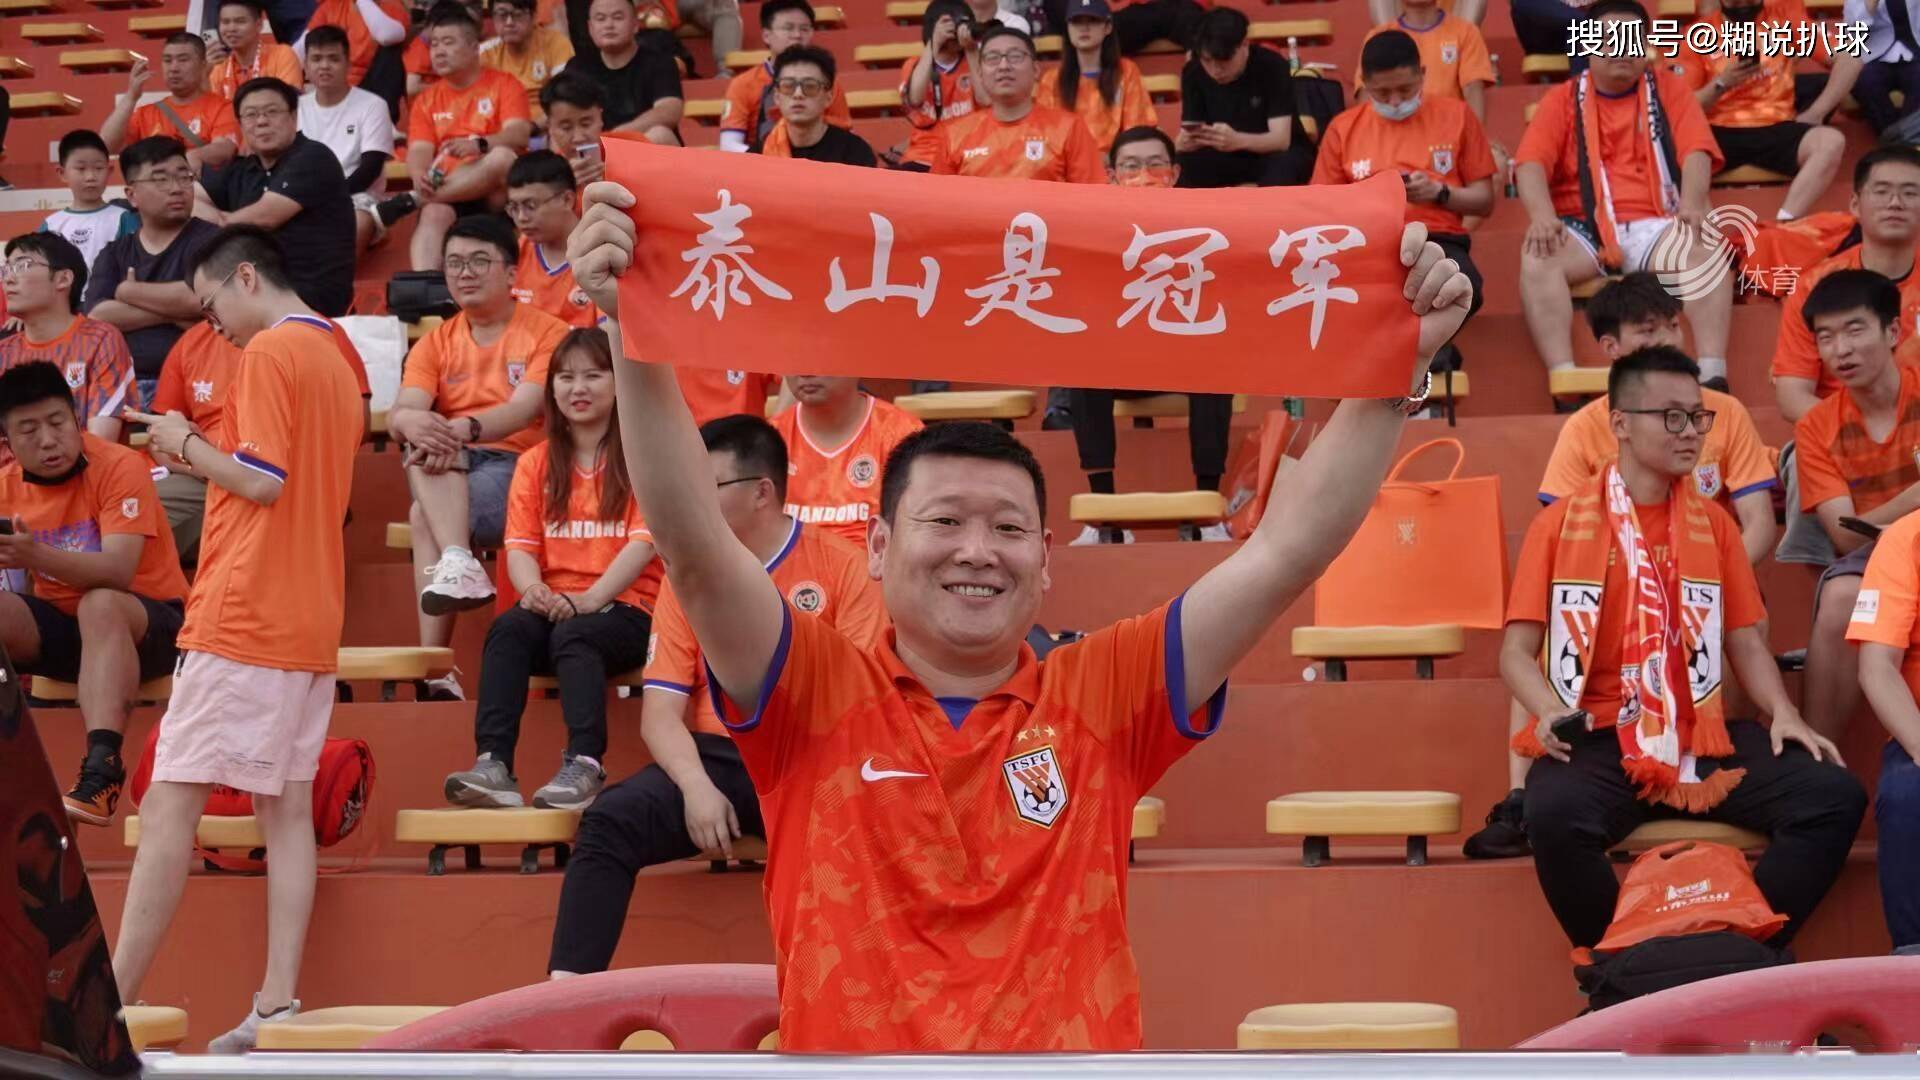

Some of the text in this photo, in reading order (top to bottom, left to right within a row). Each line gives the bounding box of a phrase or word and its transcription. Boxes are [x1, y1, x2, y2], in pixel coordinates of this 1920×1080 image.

[670, 189, 1367, 350] 泰山是冠军
[1008, 752, 1049, 771] TSFC
